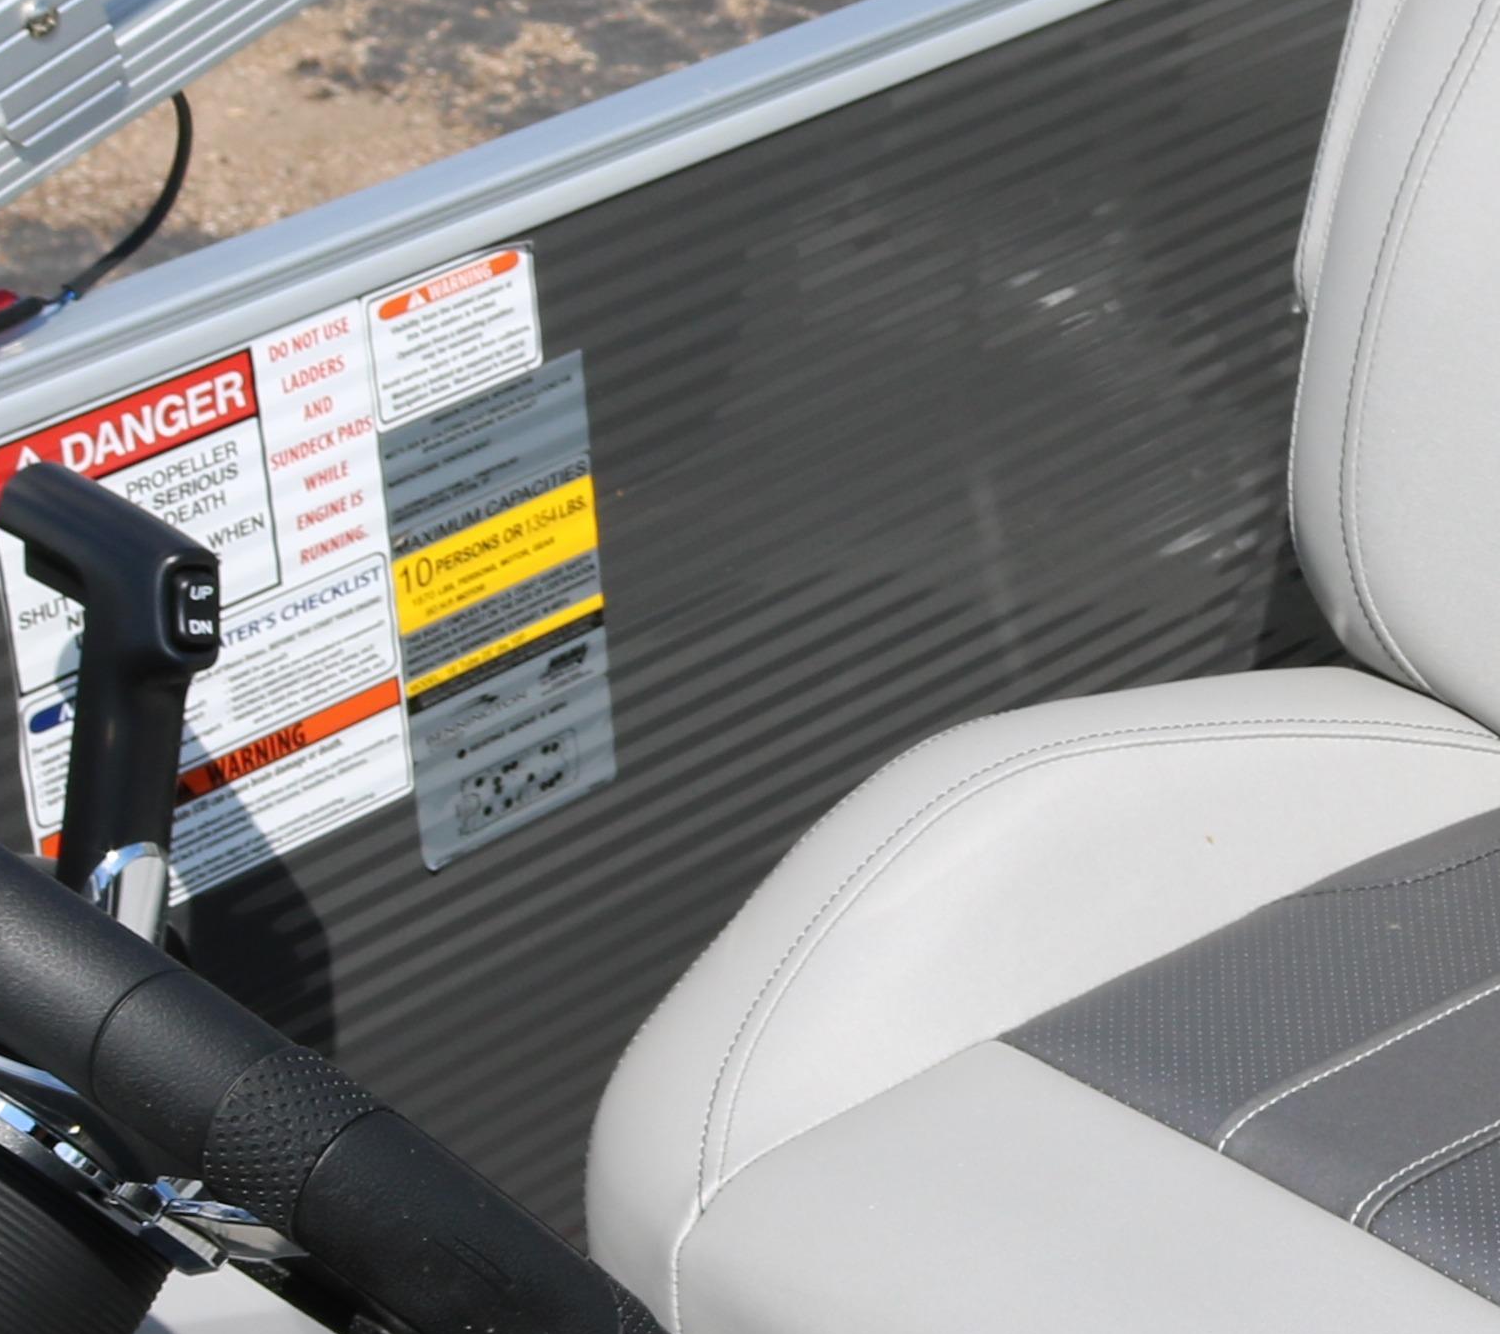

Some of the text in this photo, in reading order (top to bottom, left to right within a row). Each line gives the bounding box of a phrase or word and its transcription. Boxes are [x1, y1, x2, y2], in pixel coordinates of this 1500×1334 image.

[428, 261, 492, 302] WARNING
[267, 315, 348, 363] DO NOT USE
[281, 352, 345, 395] LADDERS
[61, 371, 245, 474] DANGER
[302, 393, 333, 422] AND
[270, 429, 334, 471] SUNDECK
[337, 413, 372, 442] PADS
[125, 439, 238, 500] PROPELLER
[152, 461, 238, 511] SERIOUS
[303, 459, 348, 493] WHILE
[163, 488, 226, 529] DEATH
[295, 495, 346, 532] ENGINE
[350, 488, 363, 508] IS
[395, 506, 480, 557] MAXIMUM
[485, 458, 587, 518] CAPACITIES
[206, 512, 265, 551] WHEN
[299, 520, 369, 565] RUNNING.
[398, 553, 433, 597] 10
[434, 531, 500, 575] PERSONS
[502, 520, 523, 544] OR
[558, 492, 587, 519] LBS.
[189, 586, 214, 601] UP
[280, 565, 381, 623] CHECKLIST
[189, 618, 214, 634] DN
[207, 722, 305, 784] WARNING
